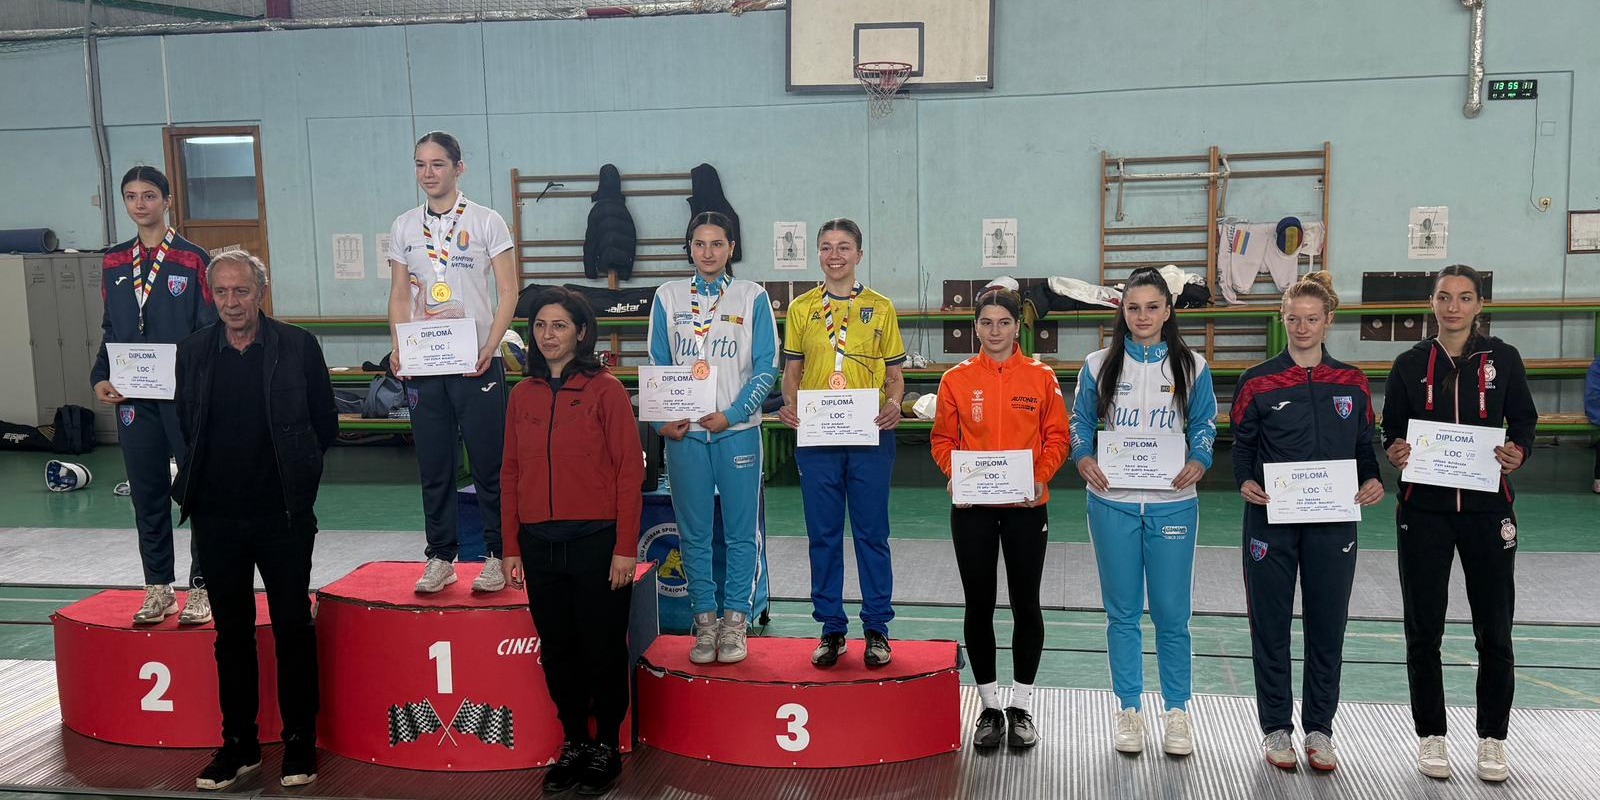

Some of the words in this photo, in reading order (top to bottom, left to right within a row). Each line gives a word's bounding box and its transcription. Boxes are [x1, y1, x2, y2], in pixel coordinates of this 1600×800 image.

[1493, 82, 1504, 90] 13
[1507, 82, 1518, 90] 55
[610, 303, 640, 313] allstar
[421, 329, 452, 338] DIPLOMĂ
[821, 398, 854, 406] DIPLOMĂ
[1115, 405, 1176, 429] uarto
[1435, 433, 1475, 444] DIPLOMĂ
[1444, 450, 1462, 458] LOC
[975, 459, 1008, 467] DIPLOMĂ
[1291, 470, 1329, 480] DIPLOMĂ
[428, 641, 453, 694] 1
[139, 661, 174, 712] 2
[775, 703, 810, 752] 3
